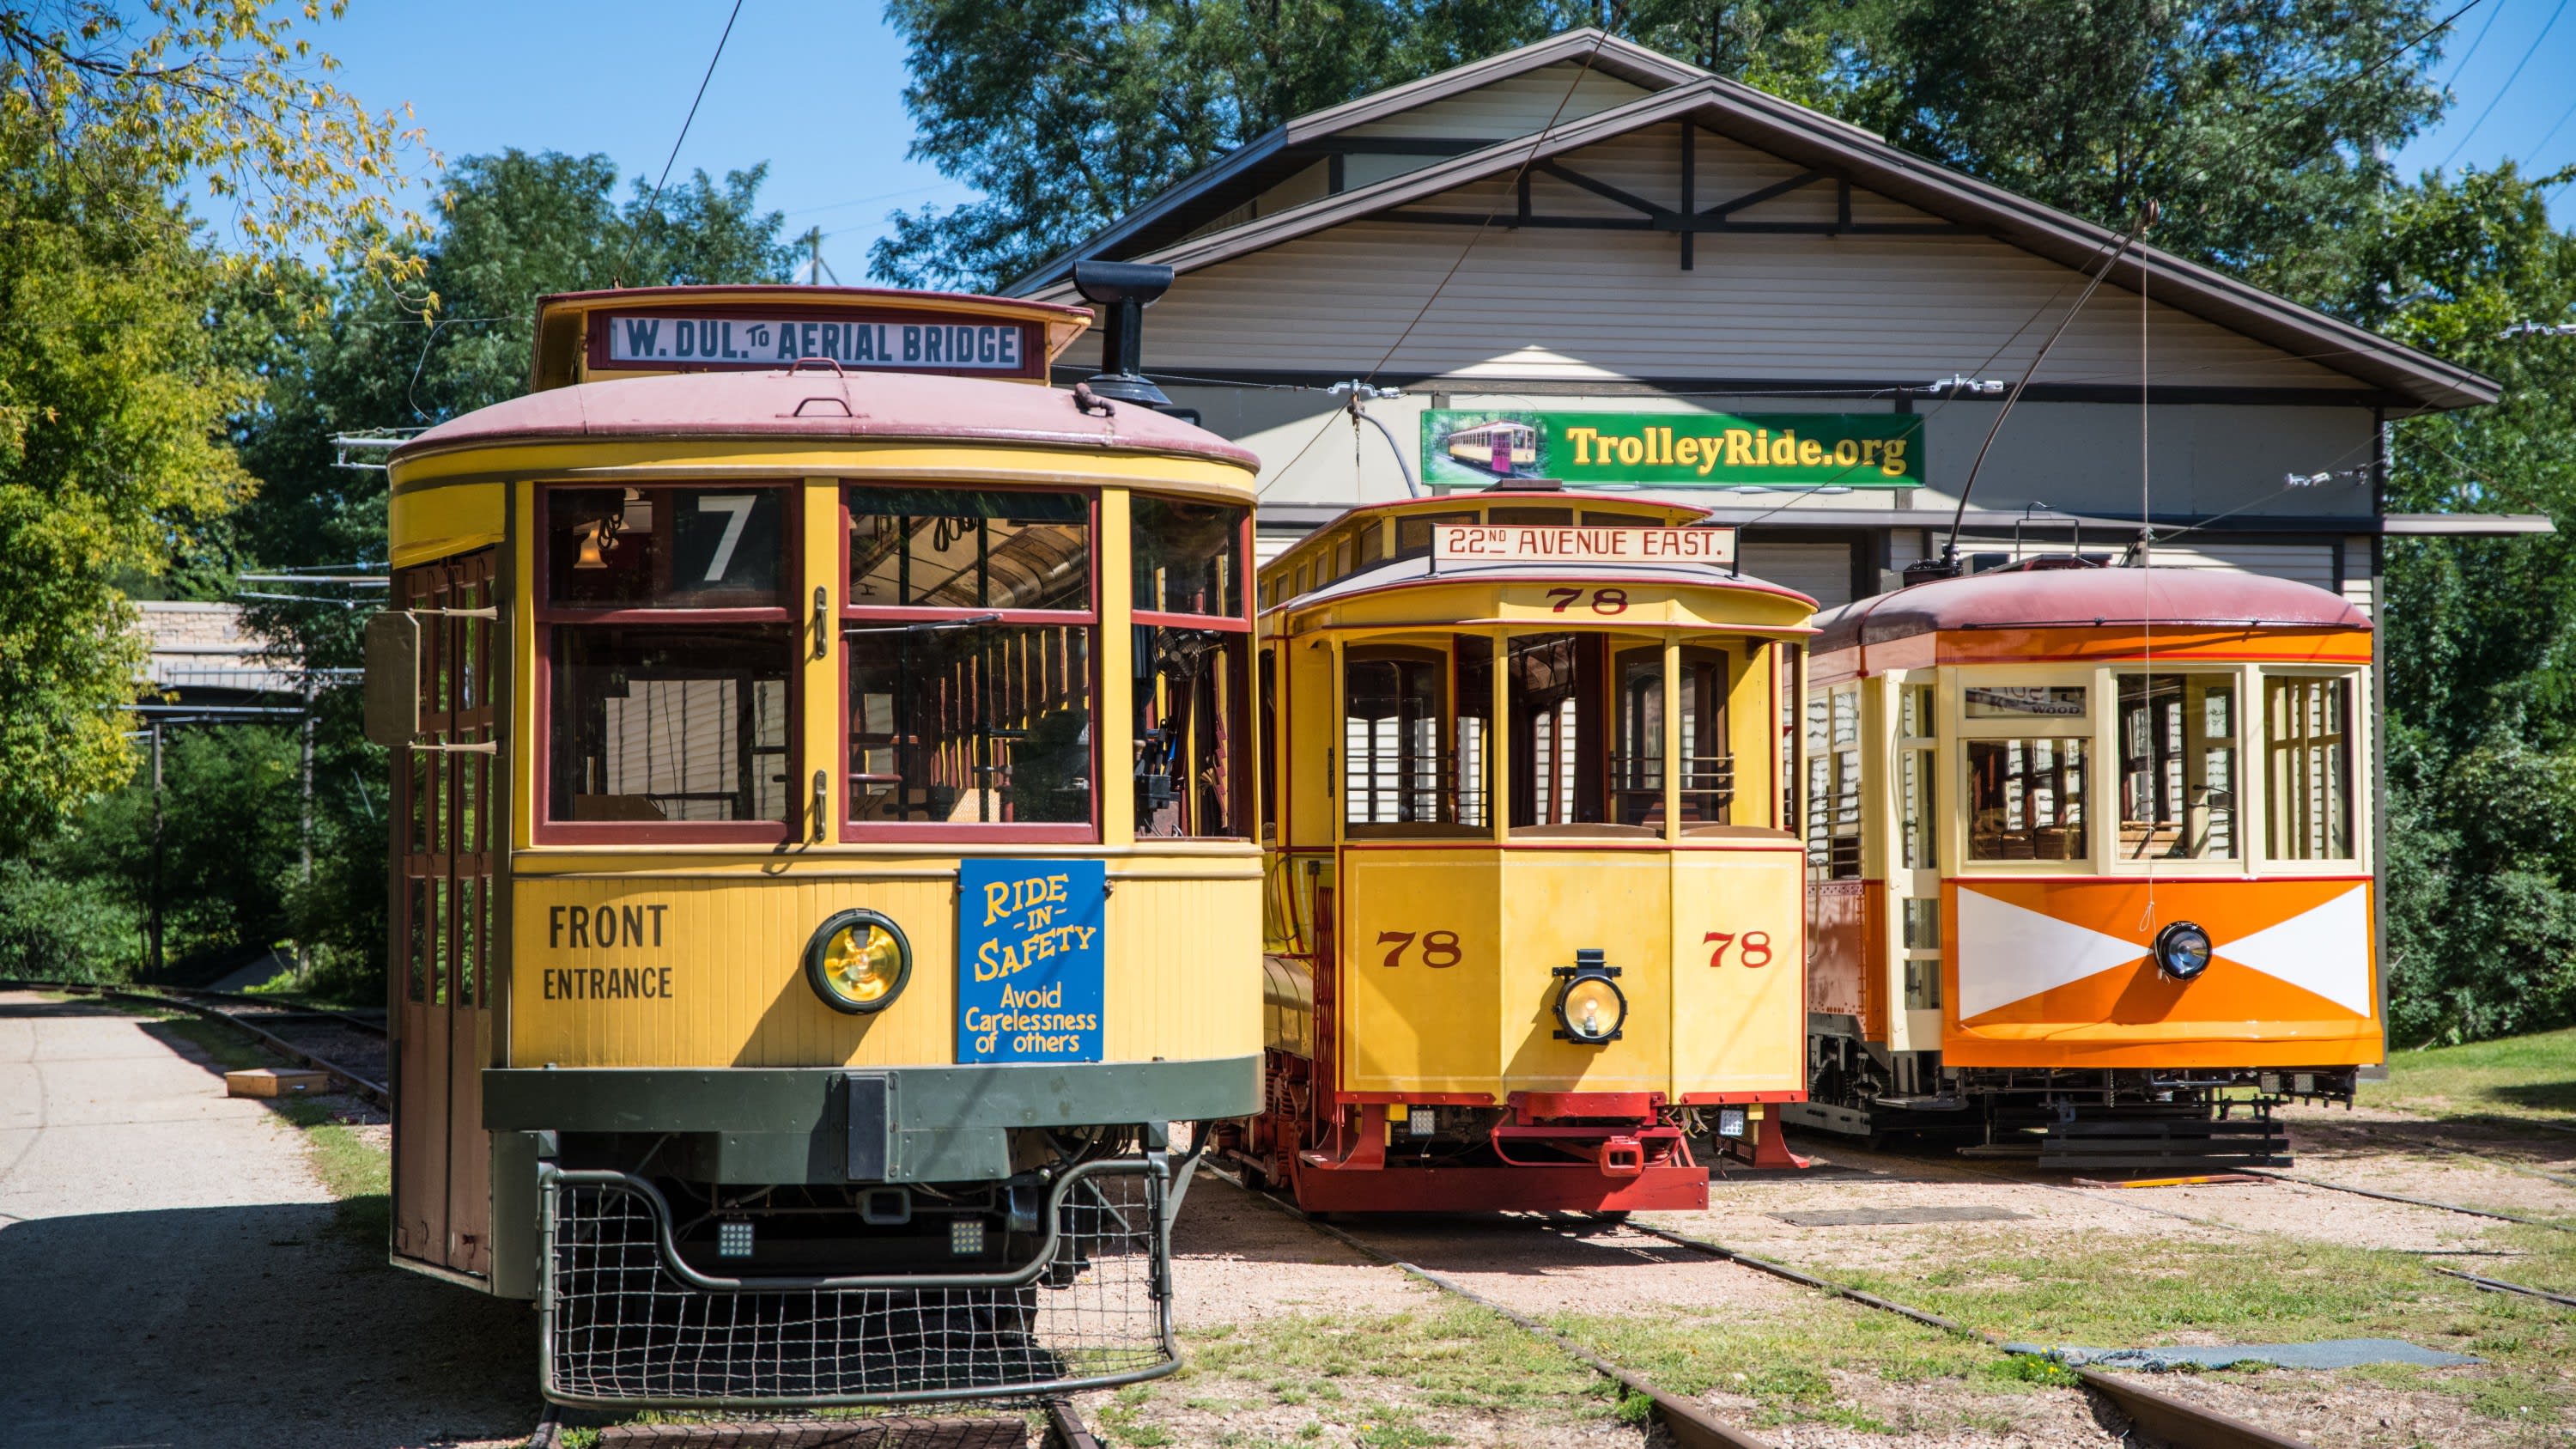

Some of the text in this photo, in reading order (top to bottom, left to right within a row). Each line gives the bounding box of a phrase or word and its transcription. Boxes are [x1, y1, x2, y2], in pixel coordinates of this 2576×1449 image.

[625, 319, 667, 357] W.
[676, 320, 750, 359] DUL.
[777, 322, 893, 362] AERIAL
[902, 325, 1016, 363] BRIDGE
[1566, 426, 1908, 476] TrolleyRide.org
[698, 495, 757, 581] 7
[1518, 530, 1626, 555] AVENUE
[1643, 531, 1723, 556] EAST.
[1546, 588, 1629, 615] 78
[983, 873, 1069, 928] RIDE
[550, 904, 668, 948] FRONT
[975, 924, 1097, 982] SAFETY
[1376, 930, 1462, 969] 78
[1703, 930, 1772, 969] 78
[544, 967, 672, 1000] ENTRANCE
[1000, 981, 1061, 1008] Avoid
[965, 1006, 1097, 1032] Carelessness
[975, 1031, 1080, 1054] of others
